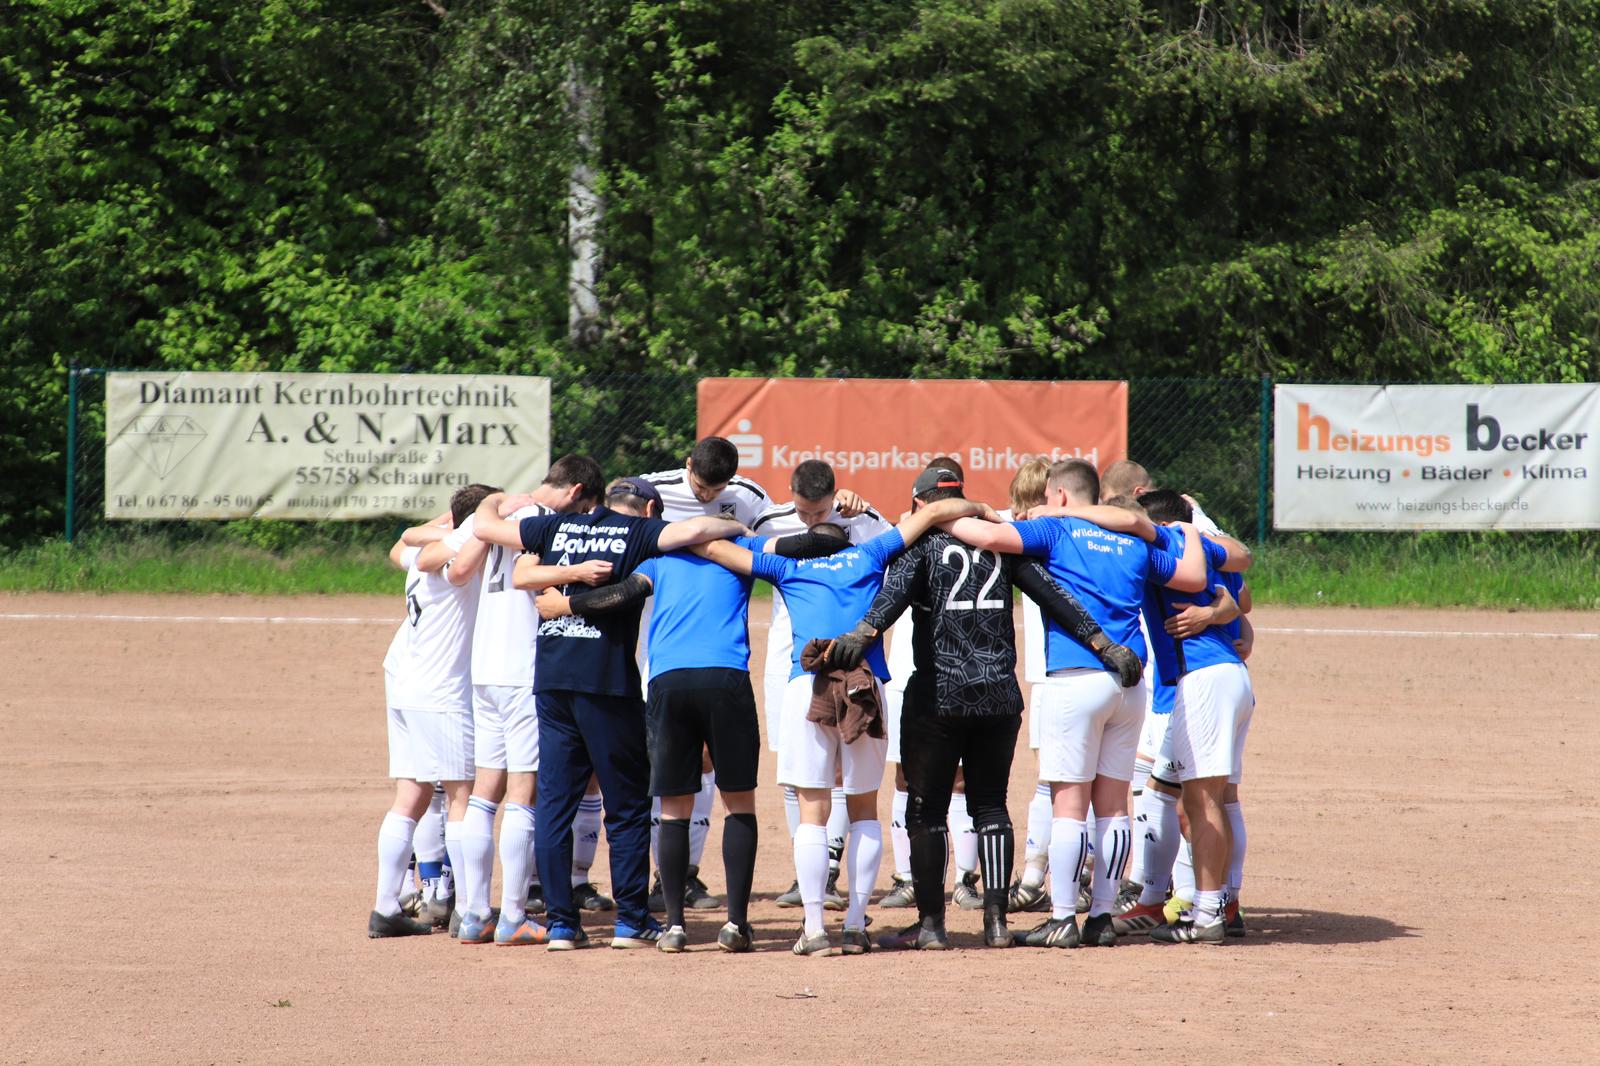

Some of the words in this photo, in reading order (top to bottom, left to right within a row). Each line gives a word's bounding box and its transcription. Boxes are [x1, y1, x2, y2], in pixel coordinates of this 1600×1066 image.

[140, 380, 264, 405] Diamant
[273, 381, 518, 408] Kernbohrtechnik
[246, 412, 289, 445] A.
[304, 413, 338, 445] &
[355, 412, 397, 446] N.
[412, 413, 520, 446] Marx
[1296, 402, 1451, 457] heizungs
[1466, 402, 1587, 451] becker
[323, 448, 429, 465] Schulstraße
[433, 449, 443, 464] 3
[296, 467, 360, 486] 55758
[367, 466, 470, 486] Schauren
[1297, 464, 1391, 483] Heizung
[1421, 465, 1491, 480] Bäder
[1522, 463, 1587, 480] Klima
[160, 495, 177, 508] 67
[214, 495, 230, 508] 95
[287, 495, 329, 508] mobil
[401, 495, 436, 509] 8195
[1355, 495, 1529, 516] www.heizungs-becker.de
[551, 532, 627, 554] Bouwe
[942, 544, 1005, 610] 22
